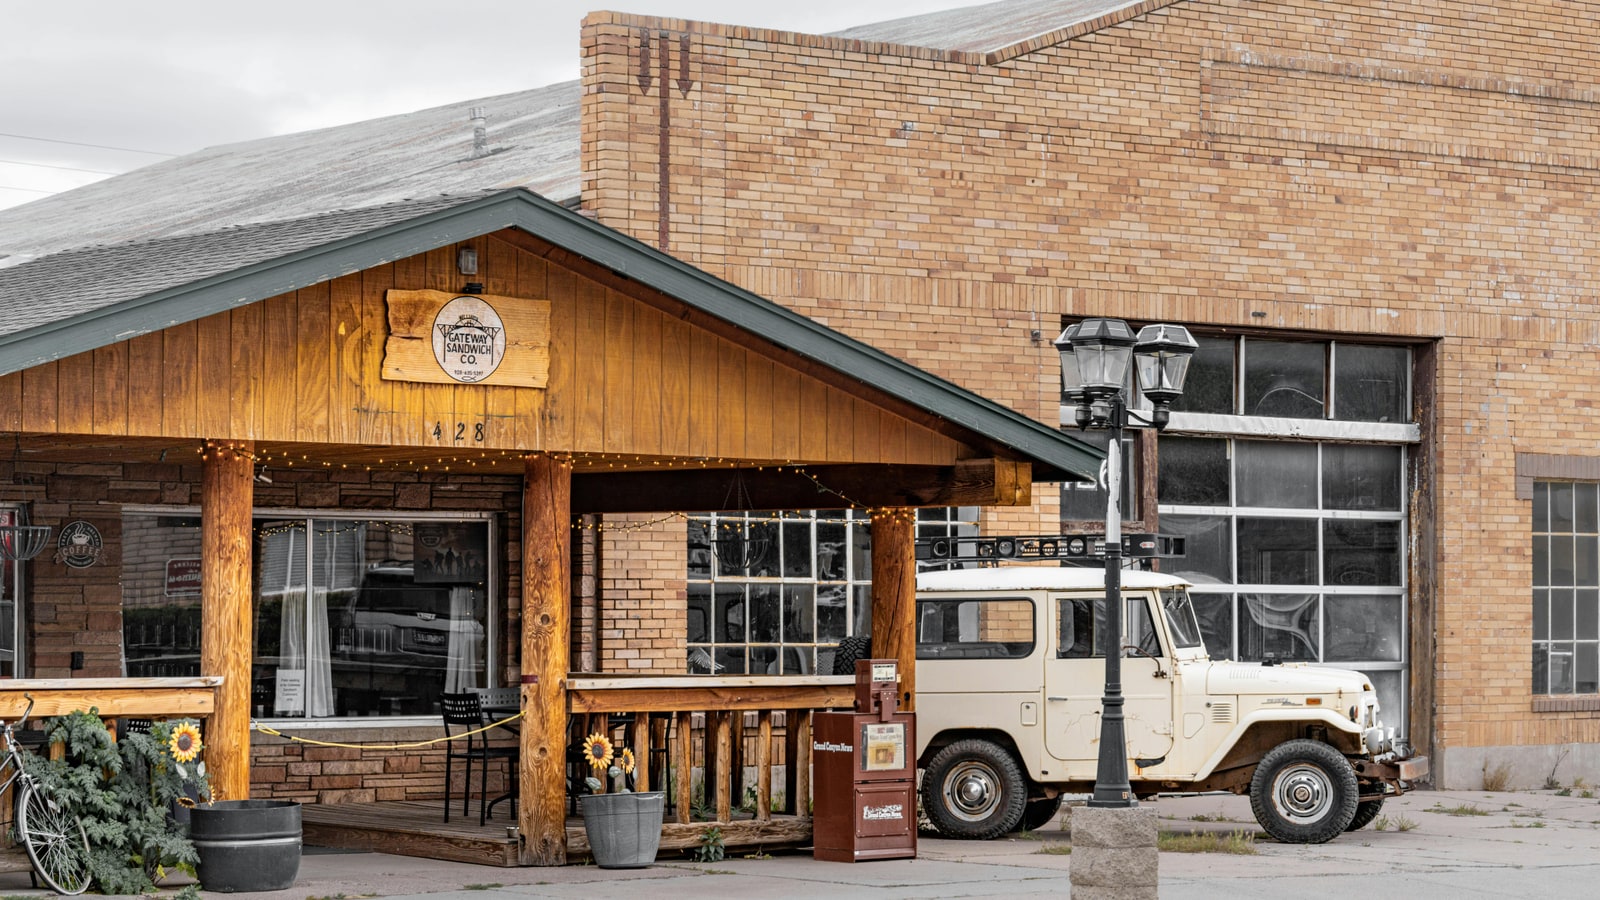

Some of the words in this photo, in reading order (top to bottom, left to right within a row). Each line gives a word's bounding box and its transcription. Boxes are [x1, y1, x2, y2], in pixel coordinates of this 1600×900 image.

[448, 332, 488, 344] GATEWAY
[446, 343, 491, 355] SANDWICH
[460, 354, 478, 365] CO.
[62, 545, 100, 557] COFFEE
[813, 741, 826, 750] Grand
[825, 741, 840, 752] Canyon
[840, 742, 853, 752] News
